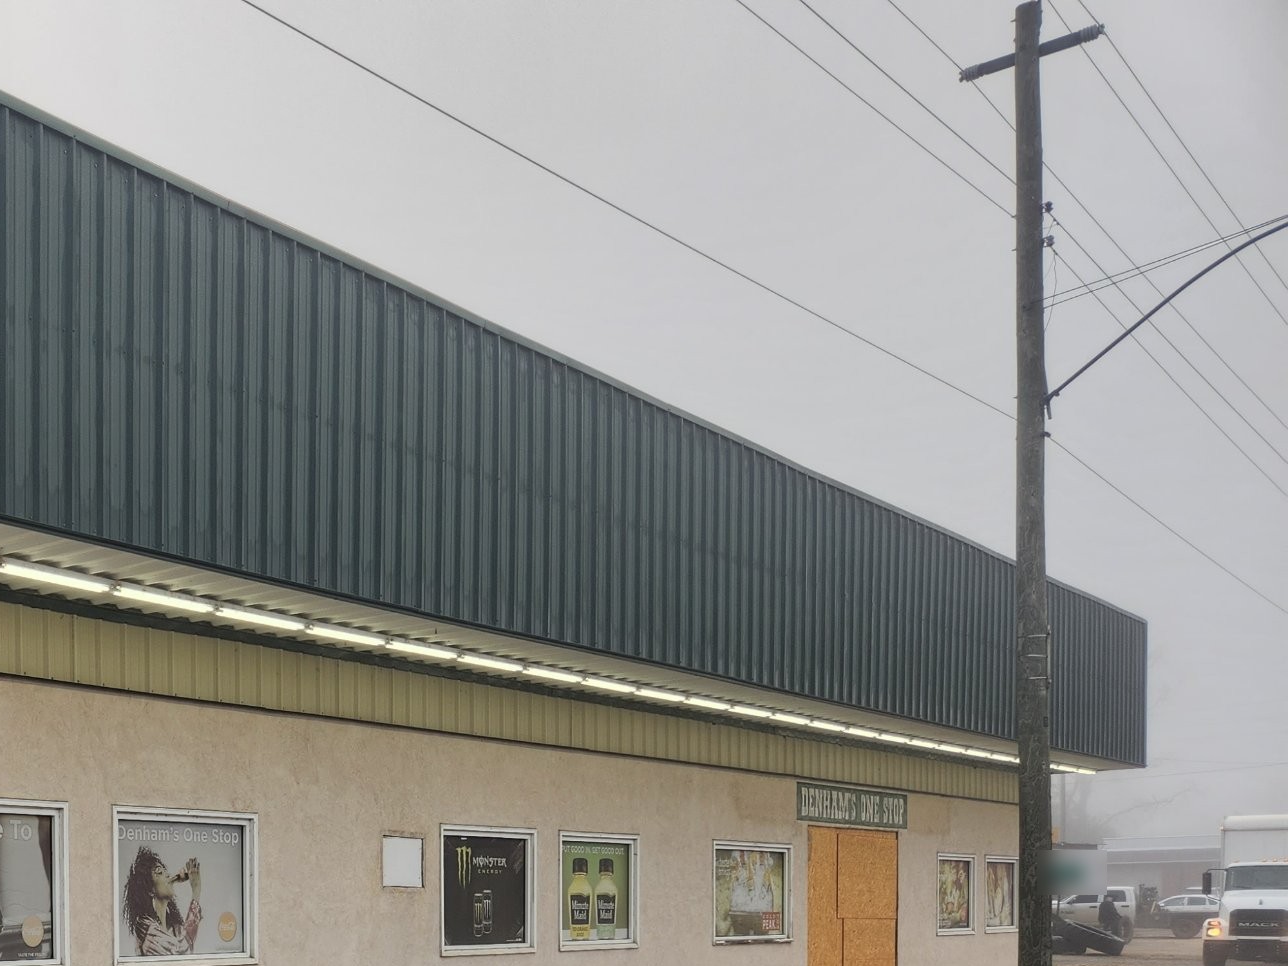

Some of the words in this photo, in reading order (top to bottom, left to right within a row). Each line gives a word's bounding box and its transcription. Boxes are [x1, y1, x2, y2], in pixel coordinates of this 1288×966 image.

[801, 787, 856, 820] DENHAM'S
[861, 794, 880, 823] ONE
[883, 797, 904, 824] STOP
[9, 819, 33, 841] To
[118, 825, 180, 842] Denham's
[183, 828, 208, 843] One
[211, 829, 239, 847] Stop
[570, 846, 585, 854] GOOD
[602, 847, 615, 855] GOOD
[472, 856, 507, 867] MONSTER
[573, 909, 587, 920] Maid
[599, 909, 613, 919] Maid
